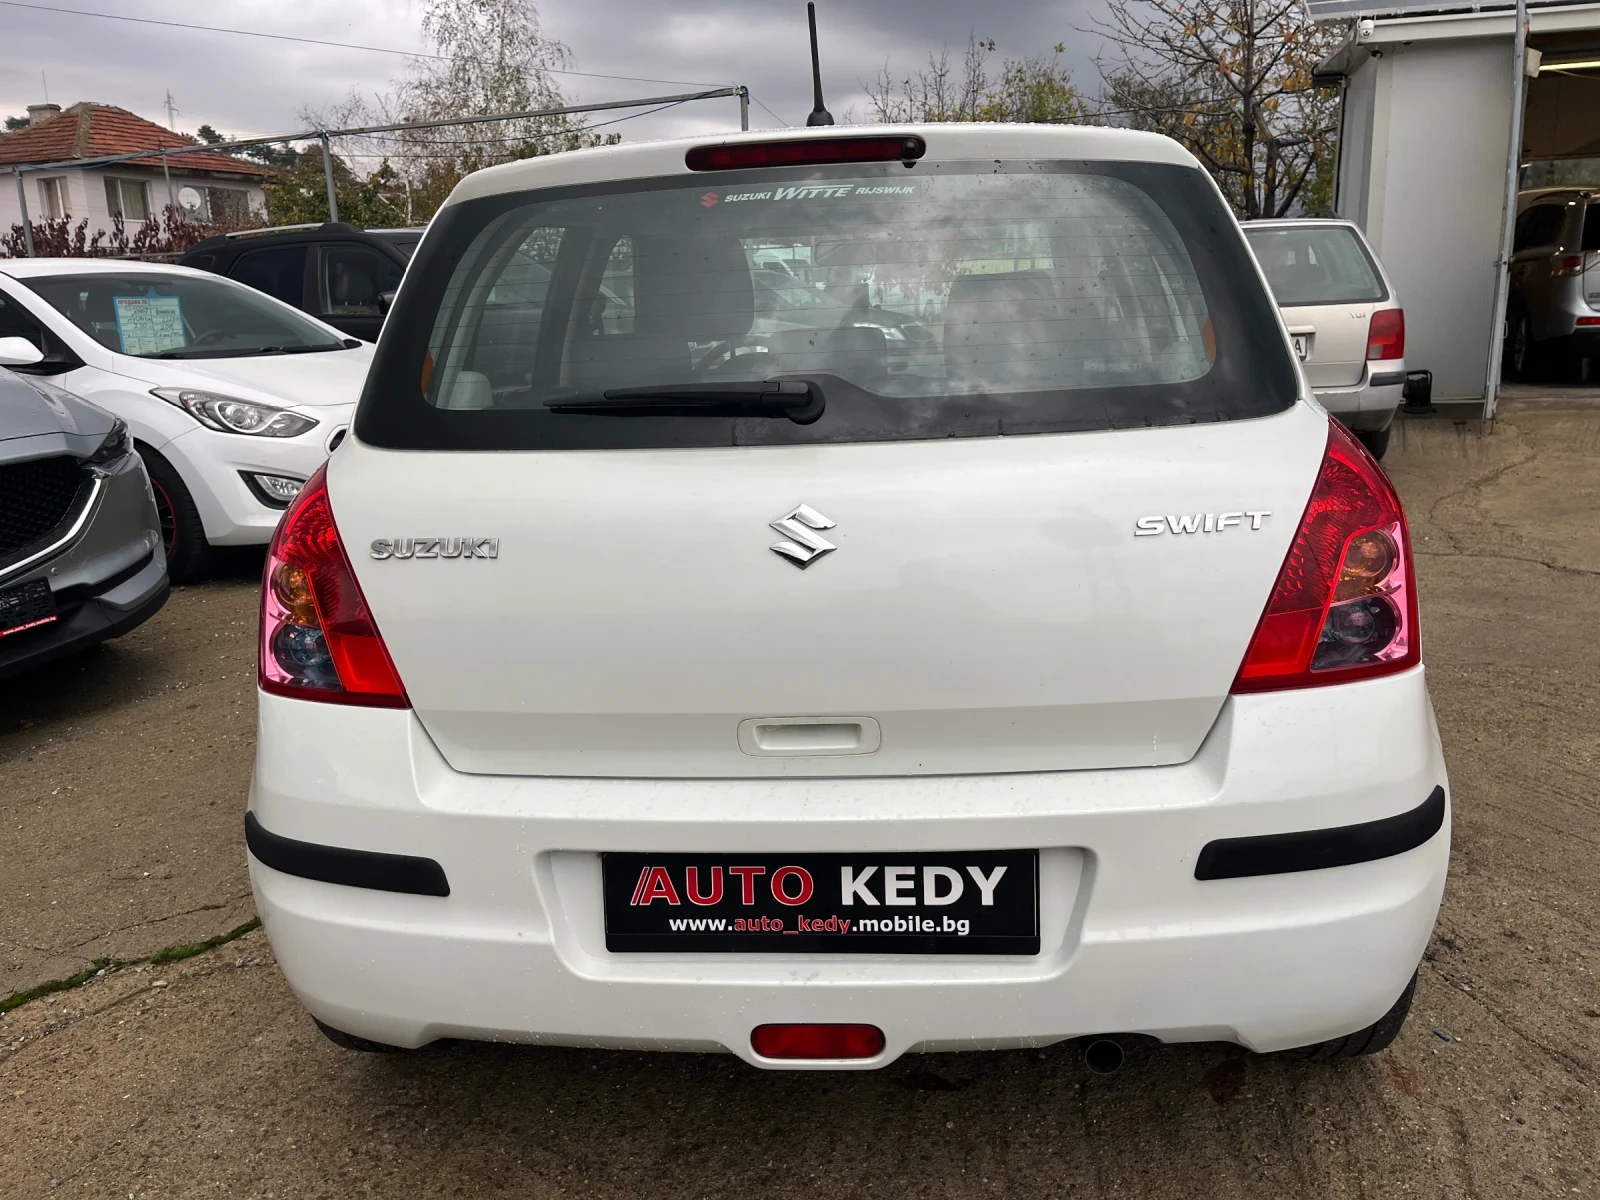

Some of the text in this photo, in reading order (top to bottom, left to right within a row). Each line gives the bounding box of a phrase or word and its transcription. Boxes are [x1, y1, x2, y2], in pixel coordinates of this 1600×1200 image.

[724, 192, 772, 202] SUZUKI
[855, 186, 916, 195] RIJSWIJK
[1134, 510, 1272, 536] SWIFT
[370, 537, 500, 560] SUZUKI
[840, 865, 1008, 906] KEDY
[669, 915, 970, 936] www.auto_kedy.mobile.bg
